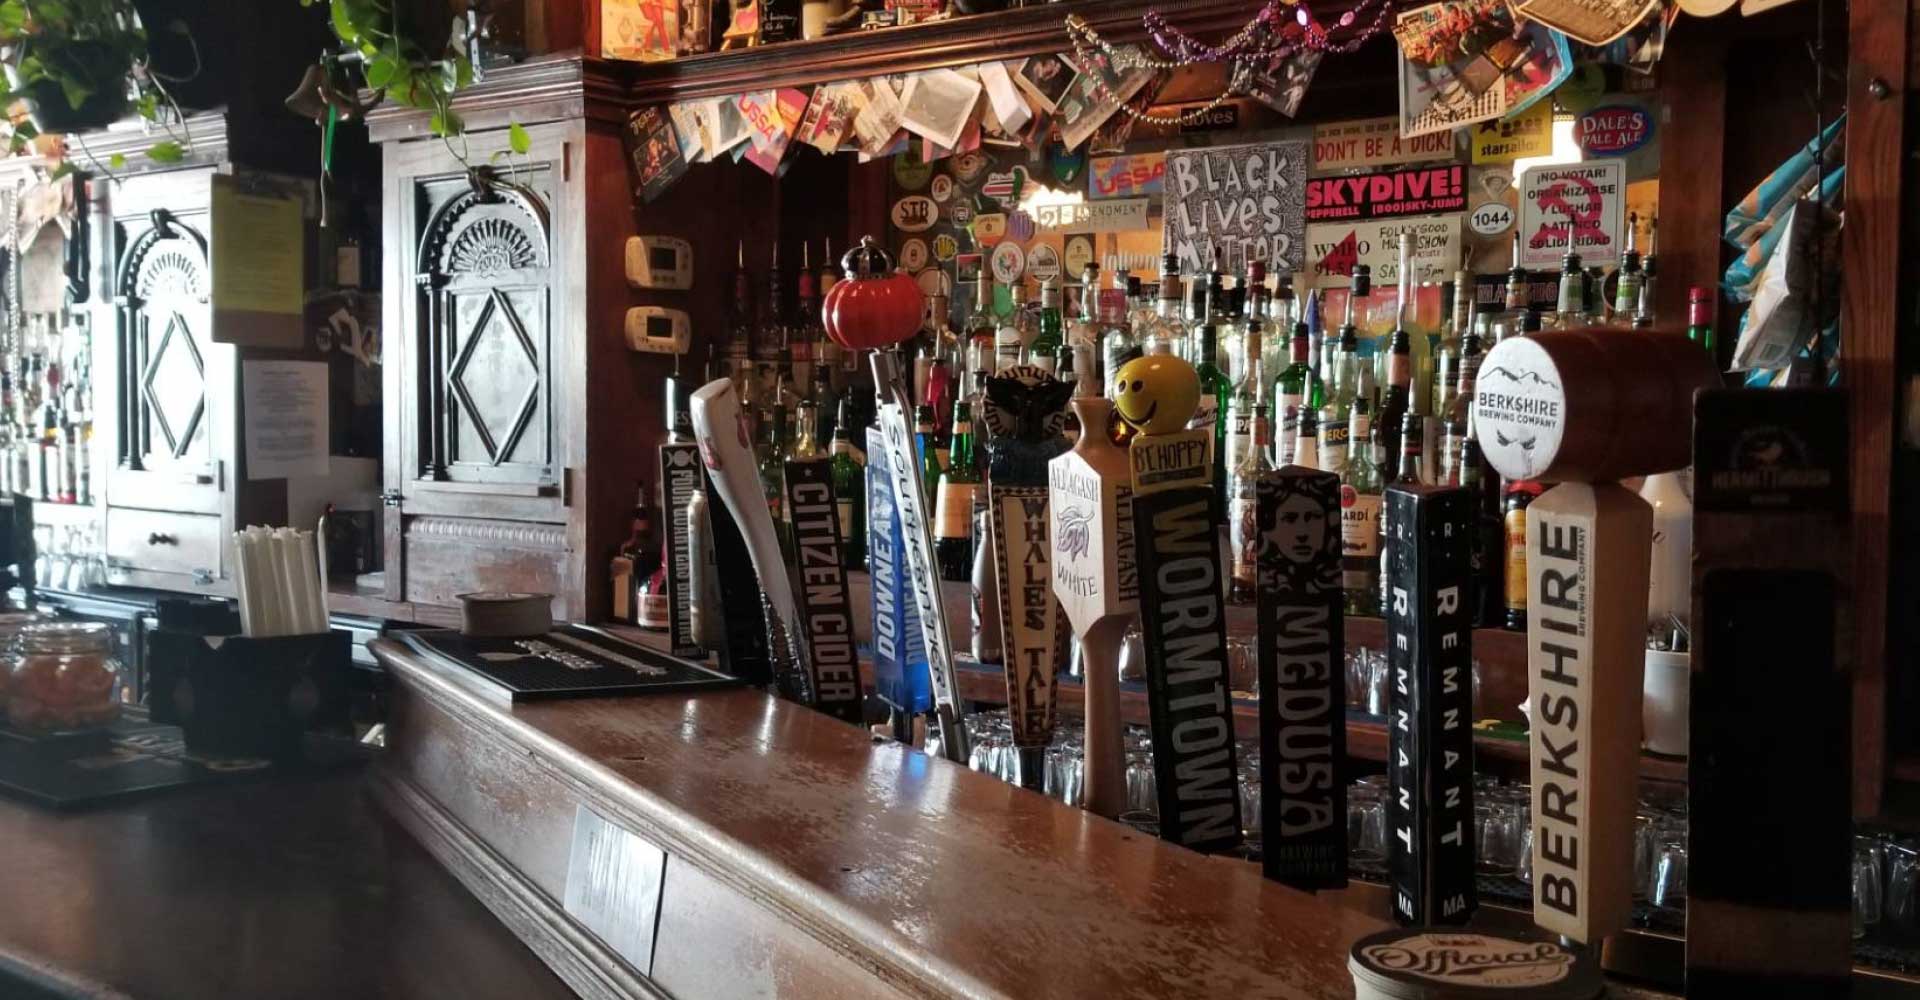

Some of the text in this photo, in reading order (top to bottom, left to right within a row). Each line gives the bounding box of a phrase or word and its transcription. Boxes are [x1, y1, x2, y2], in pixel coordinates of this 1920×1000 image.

[1581, 131, 1642, 148] PALE ALE
[1582, 112, 1644, 134] DALE'S
[1315, 141, 1358, 162] DON'T
[1365, 138, 1383, 157] BE
[1391, 138, 1402, 156] A
[1411, 129, 1452, 153] DICK!
[1095, 161, 1167, 194] USSA
[1174, 151, 1289, 199] BLACK
[1307, 166, 1462, 207] SKYDIVE!
[1474, 210, 1510, 227] 1044
[1418, 235, 1448, 249] SHOW
[1478, 408, 1558, 429] BREWING COMPANY
[1479, 392, 1559, 417] BERKSHIRE
[1051, 466, 1098, 503] ALLAGASH
[1116, 484, 1140, 602] ALLAGASH
[872, 474, 896, 662] DOWNEAST
[1056, 560, 1098, 597] WHITE
[791, 482, 857, 701] CITIZEN CIDER
[1020, 498, 1047, 737] WHALES TALE
[1152, 501, 1235, 845] WORMTOWN
[1277, 604, 1333, 837] MEDUSA
[1393, 585, 1413, 854] REMNANT
[1437, 585, 1463, 847] REMNANT
[1540, 520, 1579, 918] BERKSHIRE
[1398, 891, 1413, 921] MA
[1442, 893, 1467, 918] MA
[1368, 941, 1576, 977] Official
